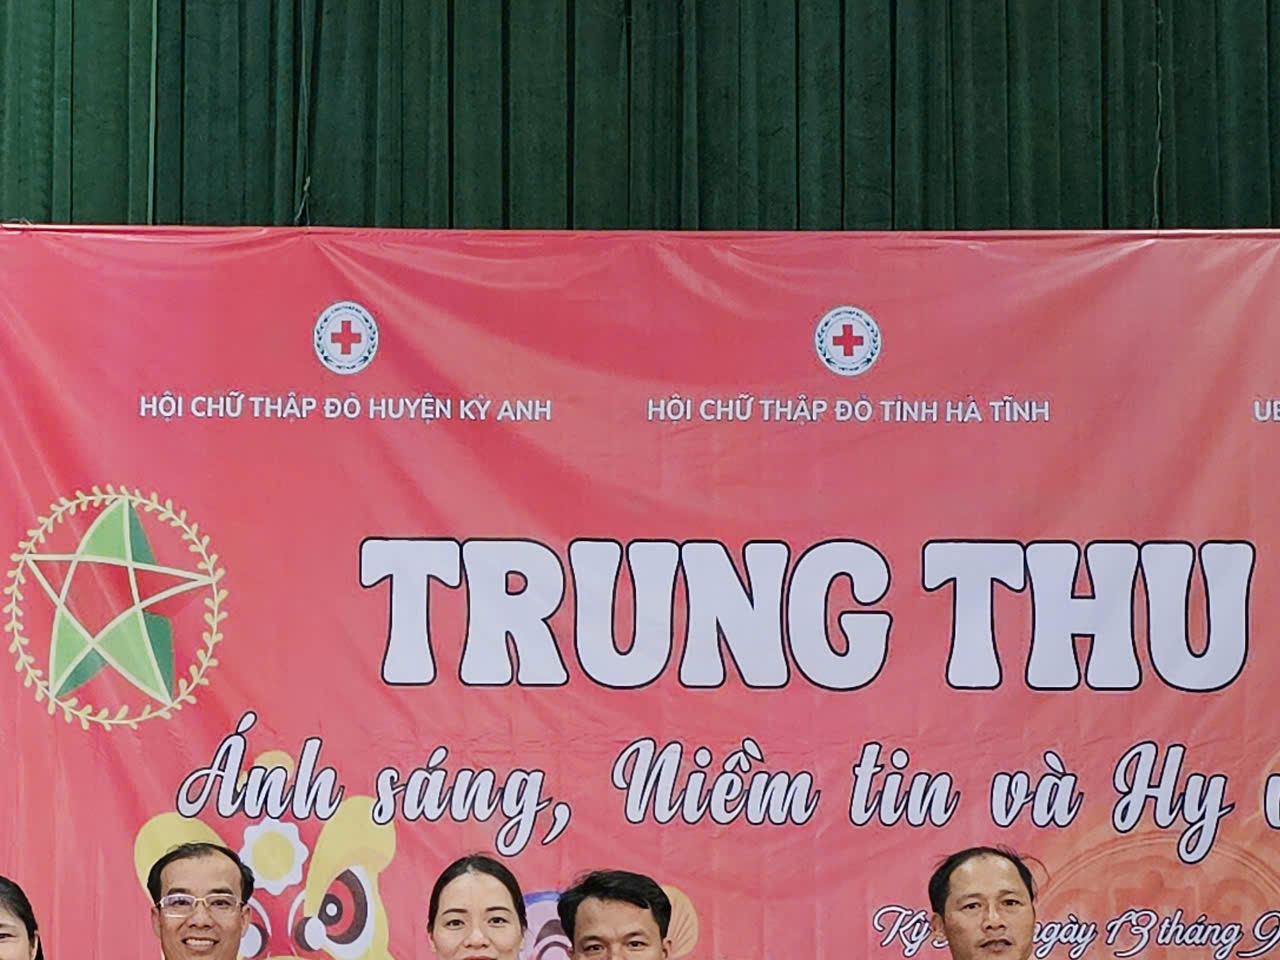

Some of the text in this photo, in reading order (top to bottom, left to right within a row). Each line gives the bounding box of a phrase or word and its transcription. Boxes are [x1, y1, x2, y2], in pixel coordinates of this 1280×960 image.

[139, 390, 183, 422] HỘI
[190, 390, 245, 418] CHỮ
[248, 391, 317, 423] THẬP
[369, 392, 452, 425] HUYỆN
[496, 399, 552, 421] ANH
[647, 393, 692, 424] HỘI
[698, 393, 755, 421] CHỮ
[759, 394, 828, 426] THẬP
[946, 395, 983, 422] HÀ
[988, 395, 1050, 423] TĨNH
[359, 537, 1256, 691] TRUNG THU
[177, 711, 343, 819] Ánh
[371, 746, 571, 857] sáng,
[612, 737, 820, 825] Niềm
[849, 741, 960, 828] tin
[991, 750, 1082, 828] và
[1112, 740, 1235, 865] Hy
[1106, 909, 1158, 958] 13
[1156, 908, 1244, 960] tháng
